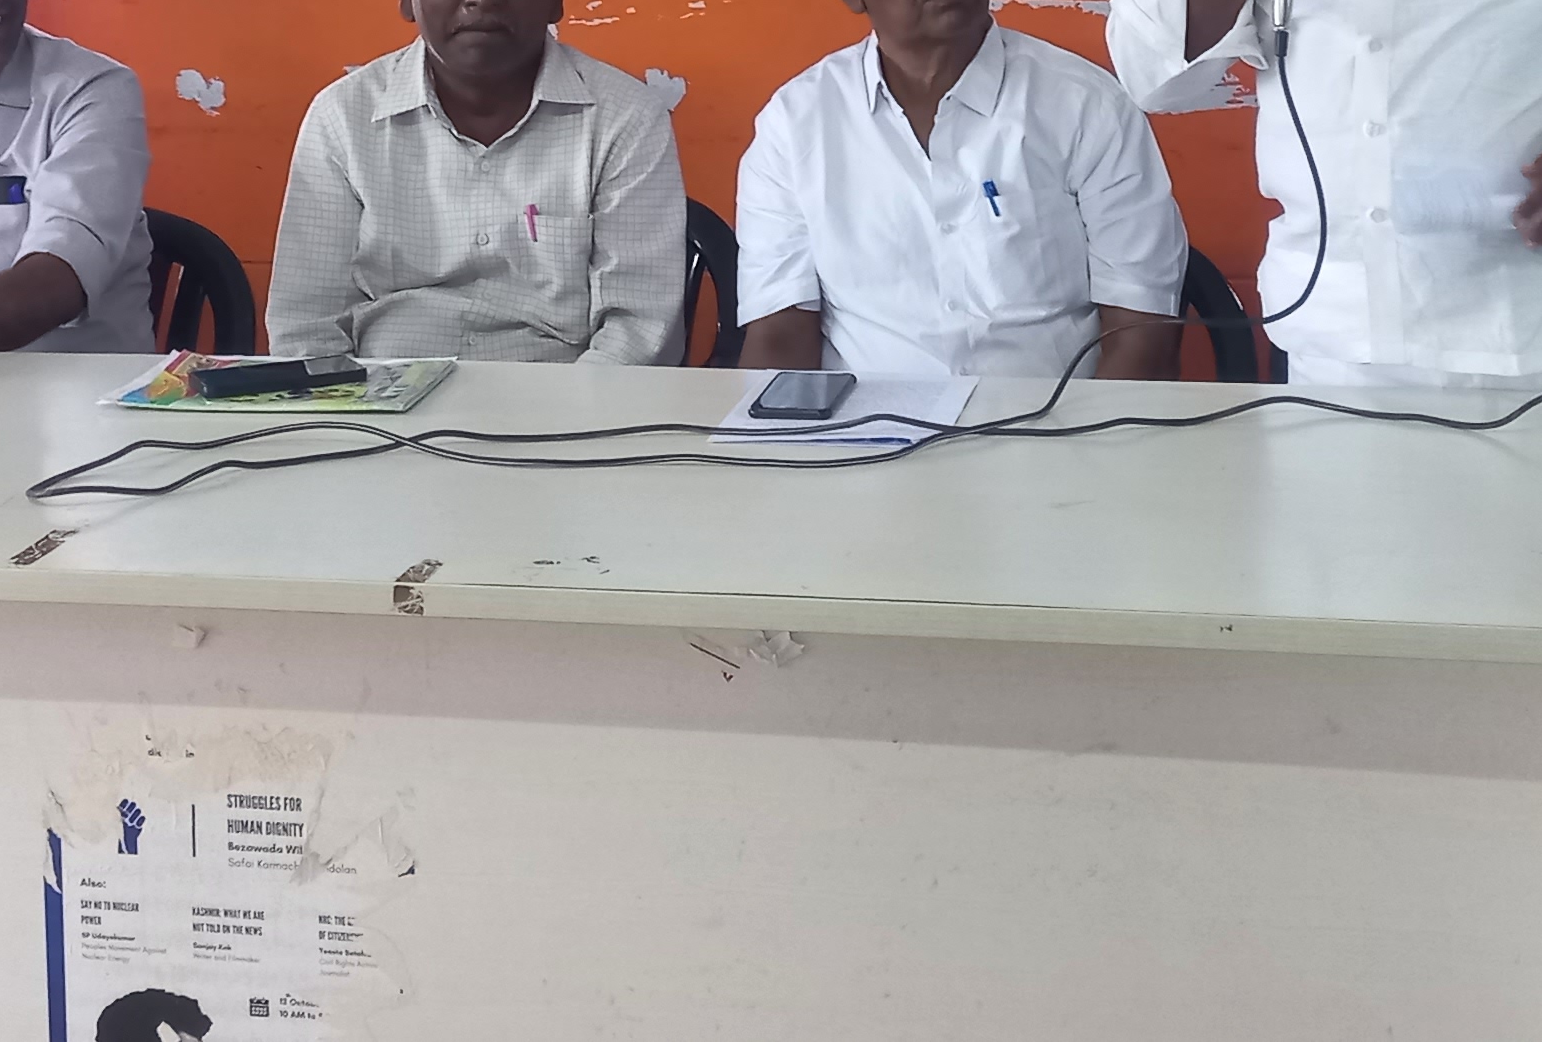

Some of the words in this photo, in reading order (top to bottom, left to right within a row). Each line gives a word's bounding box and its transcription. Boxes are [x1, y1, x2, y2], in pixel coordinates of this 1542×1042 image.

[227, 794, 280, 811] STRUGGLES
[283, 797, 302, 812] FOR
[227, 819, 263, 836] HUMAN
[265, 822, 304, 837] DIGNITY
[228, 842, 283, 854] Bezawada
[80, 878, 106, 888] Also:
[80, 900, 92, 909] SAY
[112, 902, 139, 912] NUCLEAR
[81, 915, 102, 925] POWER
[224, 909, 241, 919] WHAT
[193, 923, 205, 932] NOT
[233, 925, 243, 935] THE
[245, 926, 262, 936] NEWS
